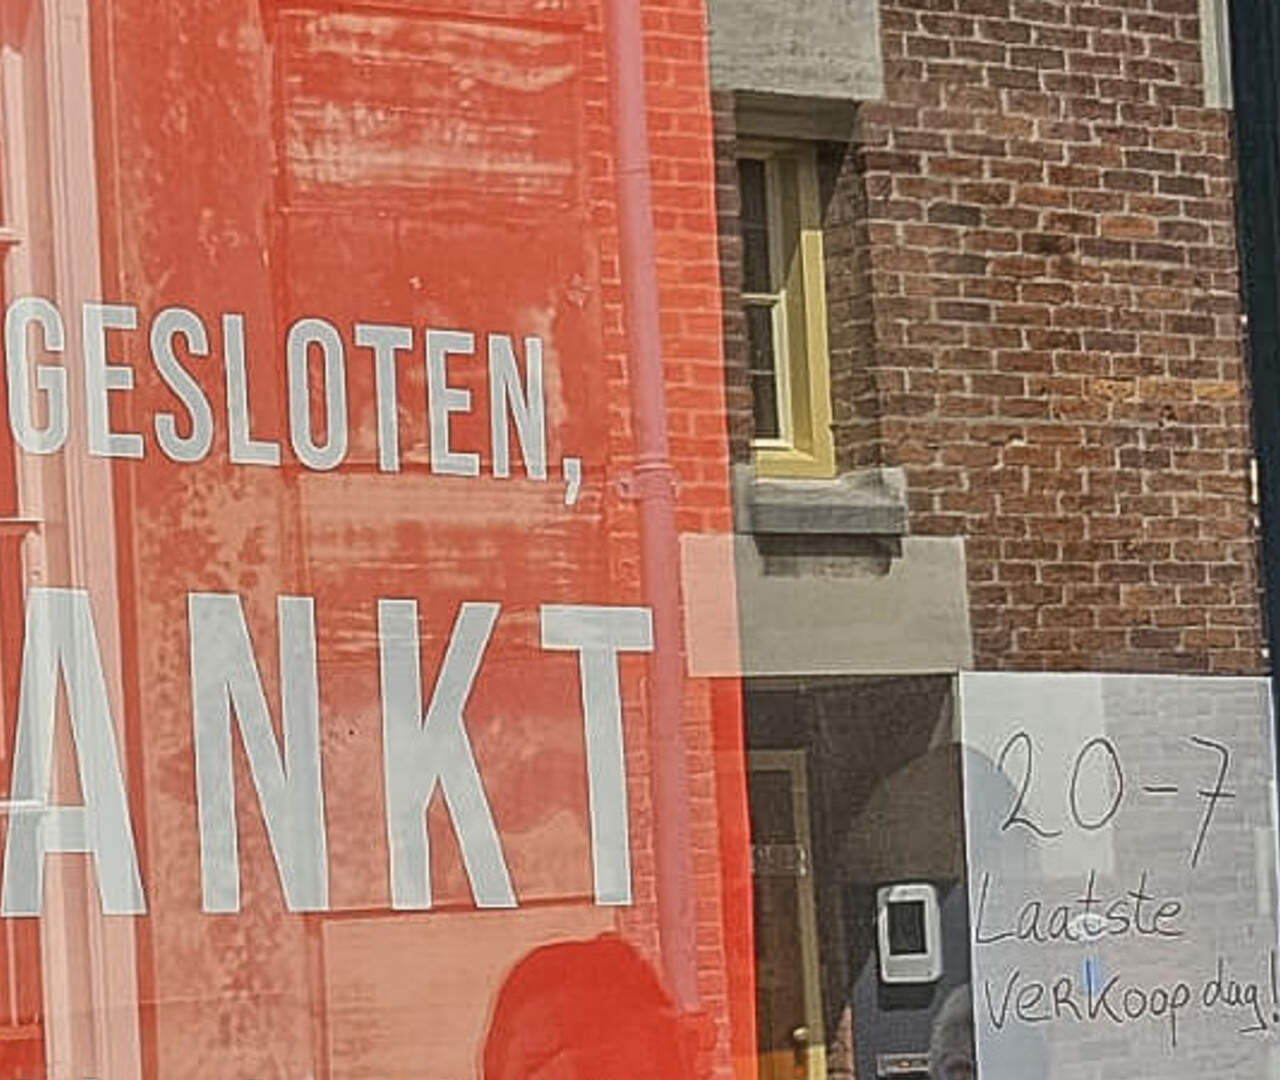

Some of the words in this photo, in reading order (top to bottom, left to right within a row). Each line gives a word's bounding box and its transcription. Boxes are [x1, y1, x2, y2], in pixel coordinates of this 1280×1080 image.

[4, 295, 583, 505] GESLOTEN,
[996, 732, 1237, 868] 20-7
[975, 869, 1186, 945] Laatste
